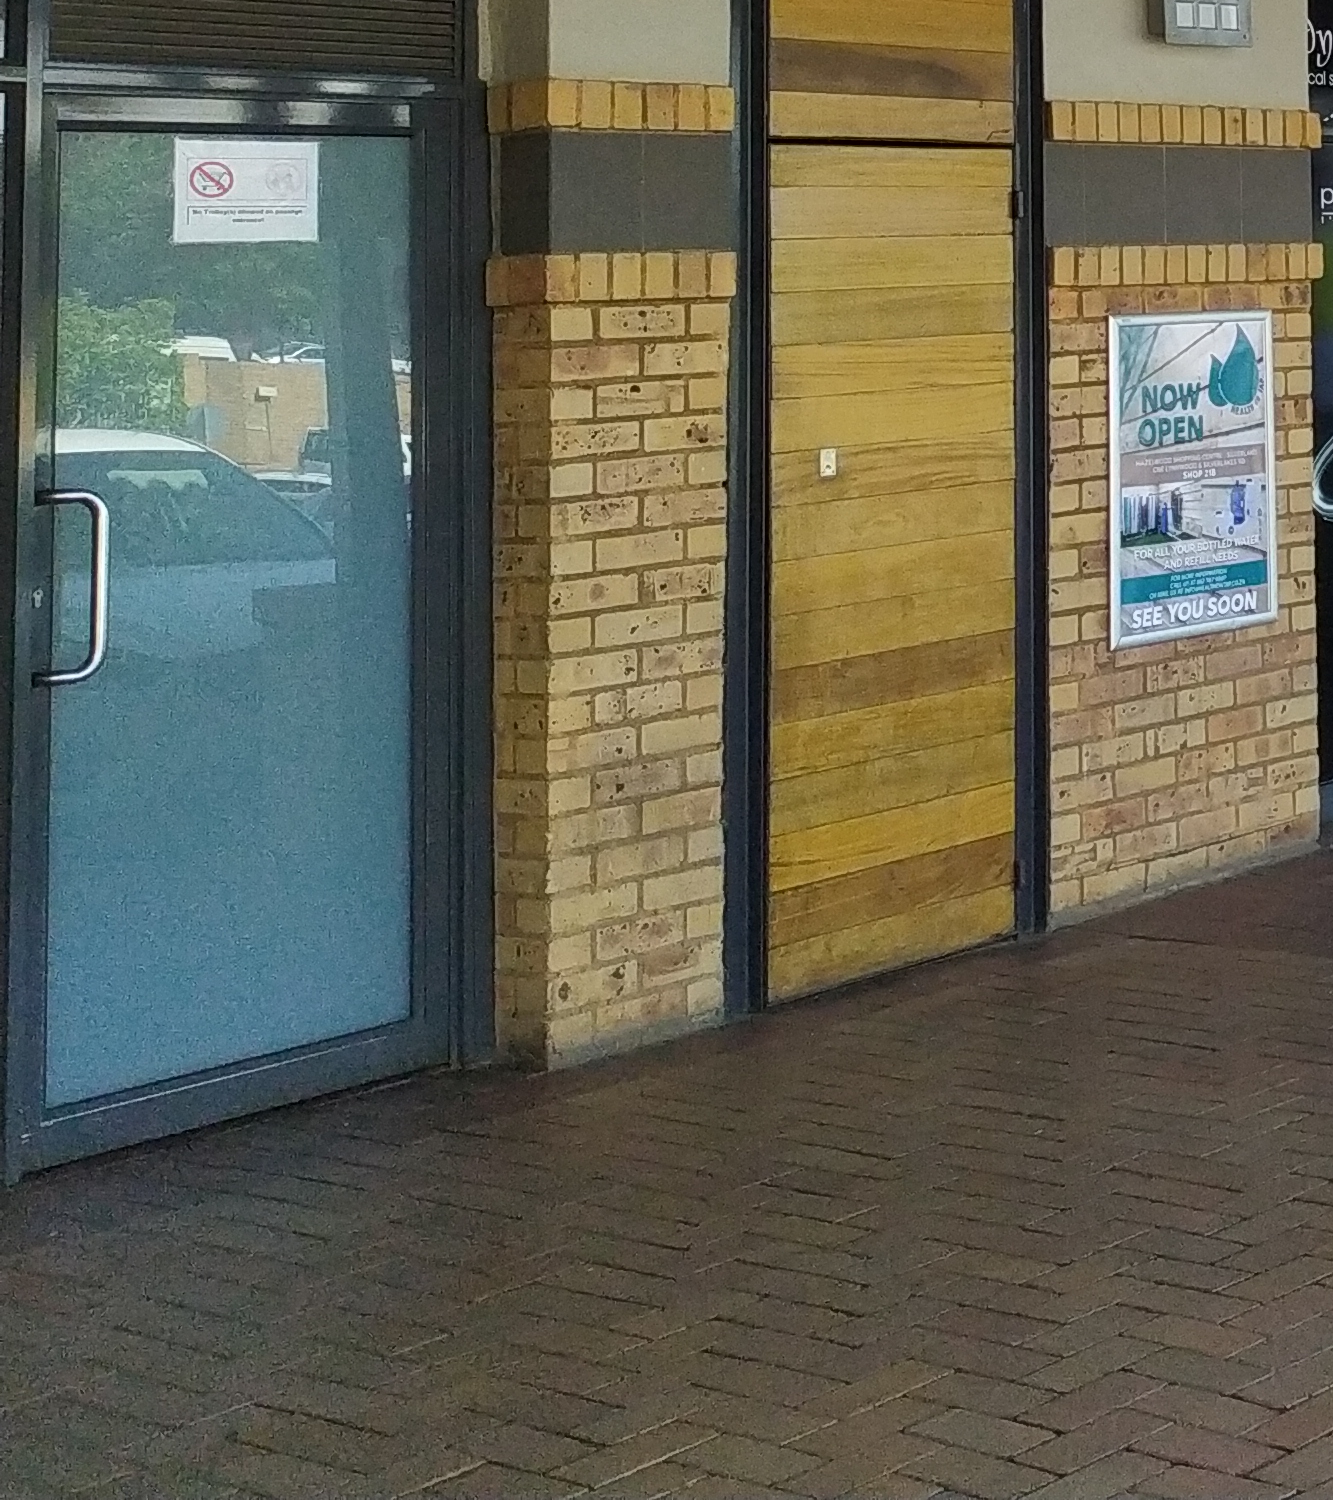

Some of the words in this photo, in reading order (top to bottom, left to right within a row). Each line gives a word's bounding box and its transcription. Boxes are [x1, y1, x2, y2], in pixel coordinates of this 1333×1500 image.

[1141, 381, 1201, 414] NOW
[1138, 414, 1204, 447] OPEN
[1183, 470, 1204, 480] SHOP
[1134, 548, 1153, 560] FOR
[1154, 546, 1171, 558] ALL
[1172, 542, 1196, 555] YOUR
[1197, 538, 1233, 552] BOTTLED
[1163, 558, 1183, 570] AND
[1184, 554, 1211, 568] REFILL
[1212, 550, 1239, 563] NEEDS
[1131, 605, 1164, 630] SEE
[1166, 599, 1204, 623] YOU
[1206, 590, 1258, 616] SOON
